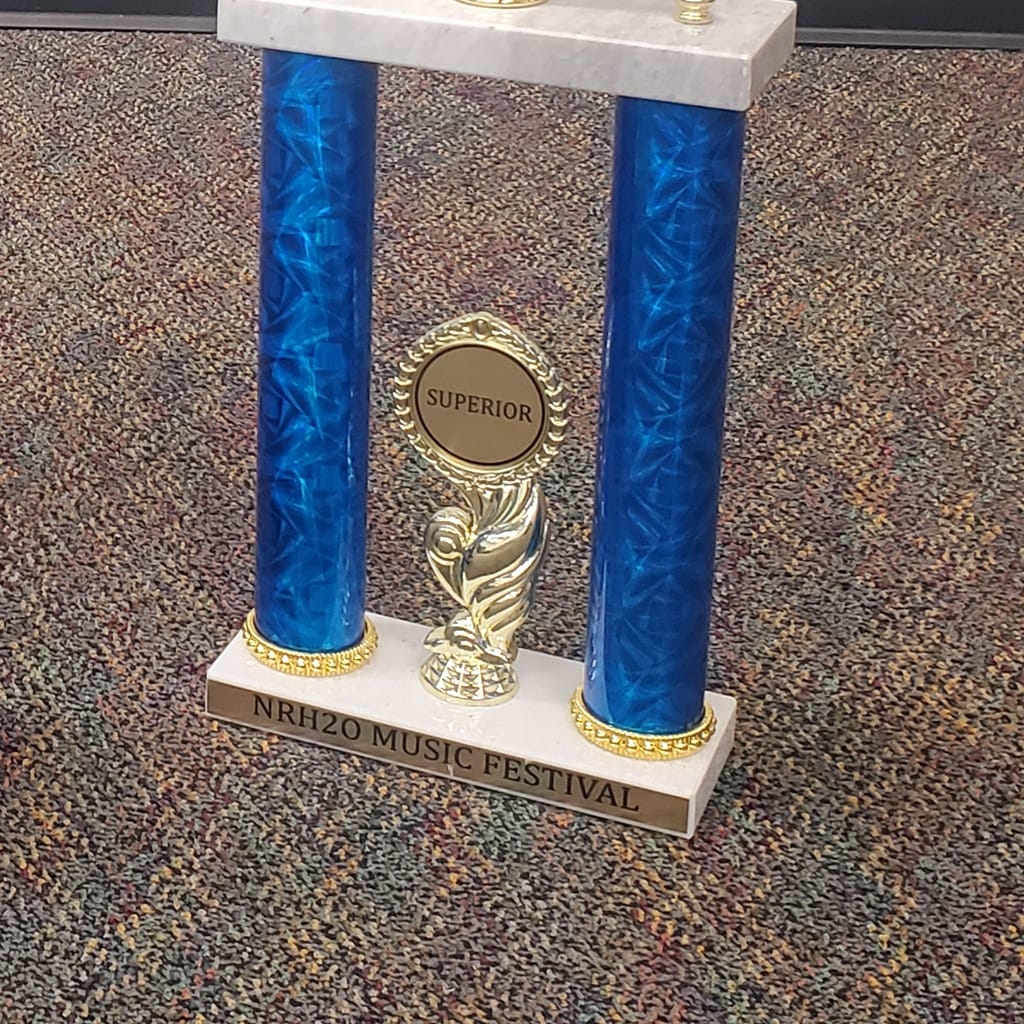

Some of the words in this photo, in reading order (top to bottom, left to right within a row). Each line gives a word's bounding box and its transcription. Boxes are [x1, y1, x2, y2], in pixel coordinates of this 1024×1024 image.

[424, 388, 533, 424] SUPERIOR
[372, 724, 474, 770] MUSIC
[482, 753, 640, 813] FESTIVAL
